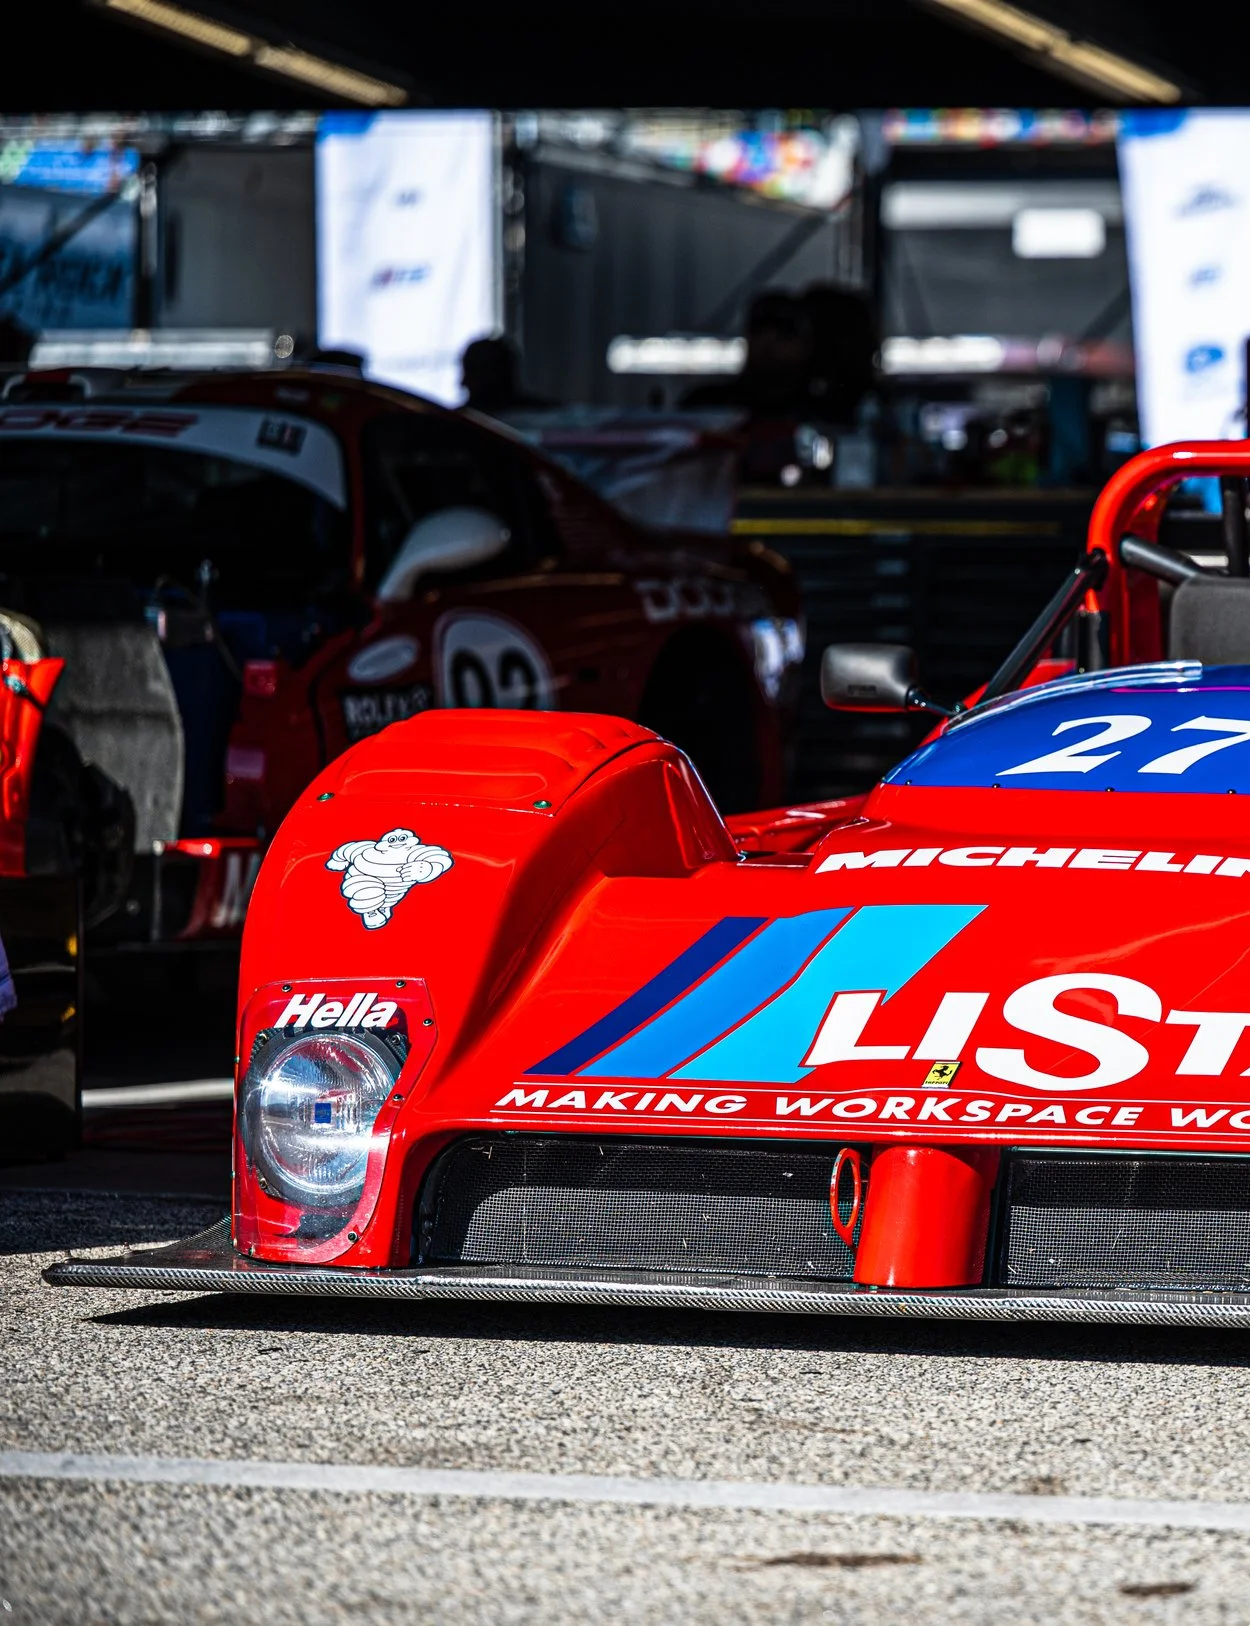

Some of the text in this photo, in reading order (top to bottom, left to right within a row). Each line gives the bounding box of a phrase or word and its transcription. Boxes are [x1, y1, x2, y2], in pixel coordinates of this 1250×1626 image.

[273, 992, 398, 1029] Hella
[494, 1088, 748, 1114] MAKING
[775, 1096, 1144, 1126] WORKSPACE
